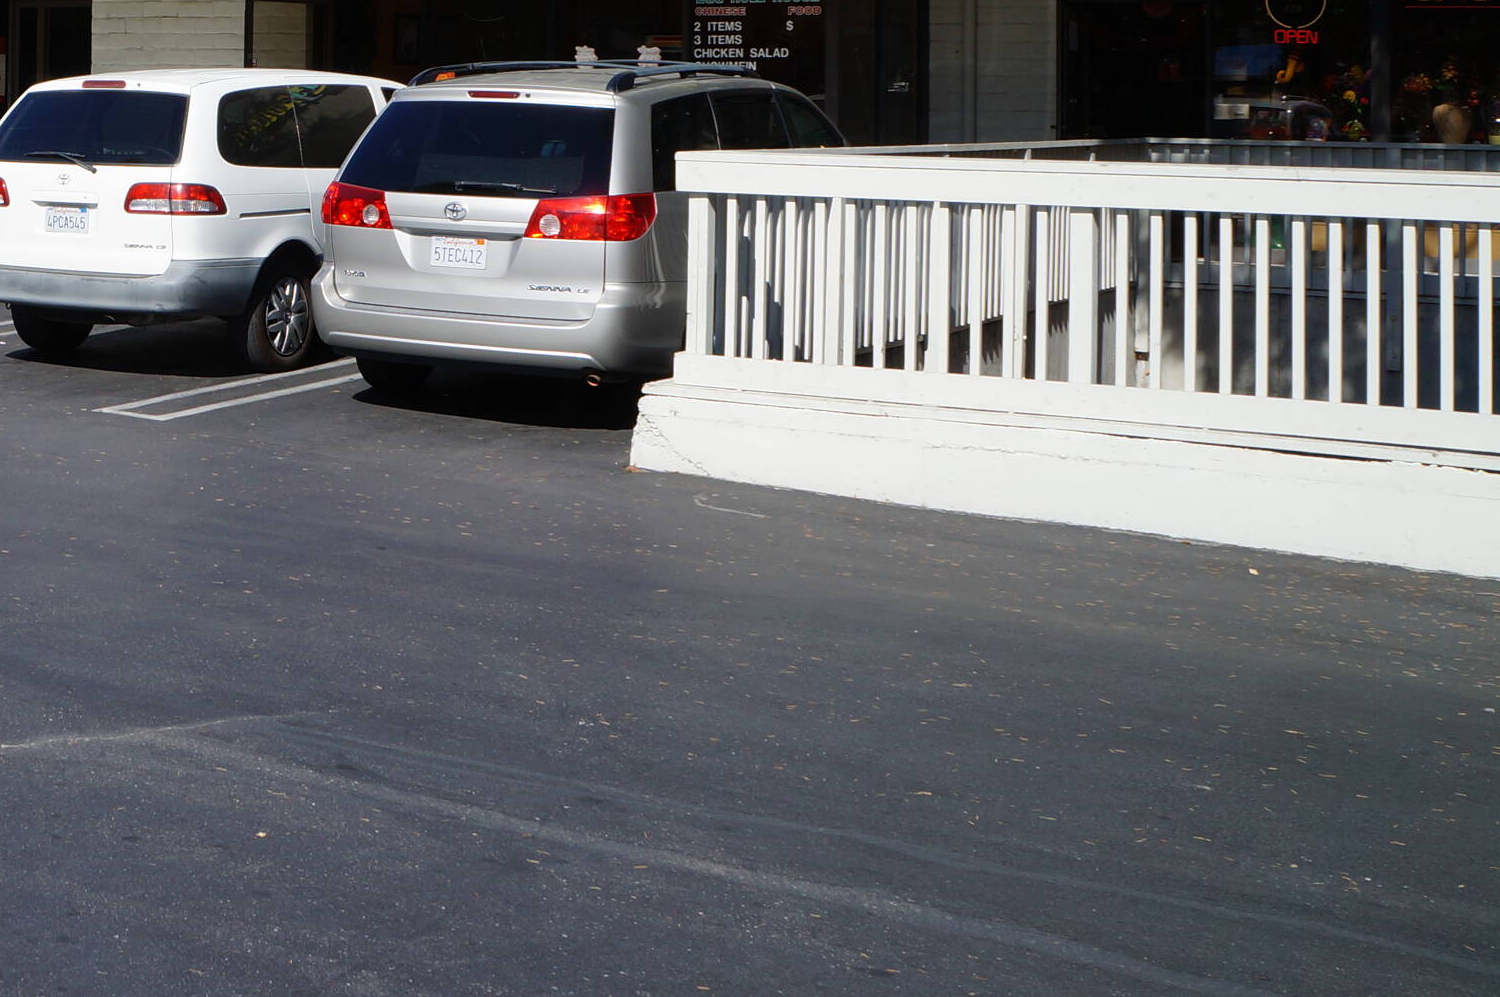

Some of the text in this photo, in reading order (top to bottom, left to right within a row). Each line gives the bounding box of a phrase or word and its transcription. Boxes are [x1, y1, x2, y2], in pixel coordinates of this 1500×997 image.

[695, 6, 822, 17] CHINESE FOOD
[693, 21, 701, 32] 2
[707, 21, 743, 32] ITEMS
[693, 34, 743, 45] 3 ITEMS
[1273, 29, 1319, 44] OPEN
[693, 48, 790, 59] CHICKEN SALAD
[47, 214, 86, 230] 4PCA545
[434, 246, 483, 265] 5TEC412
